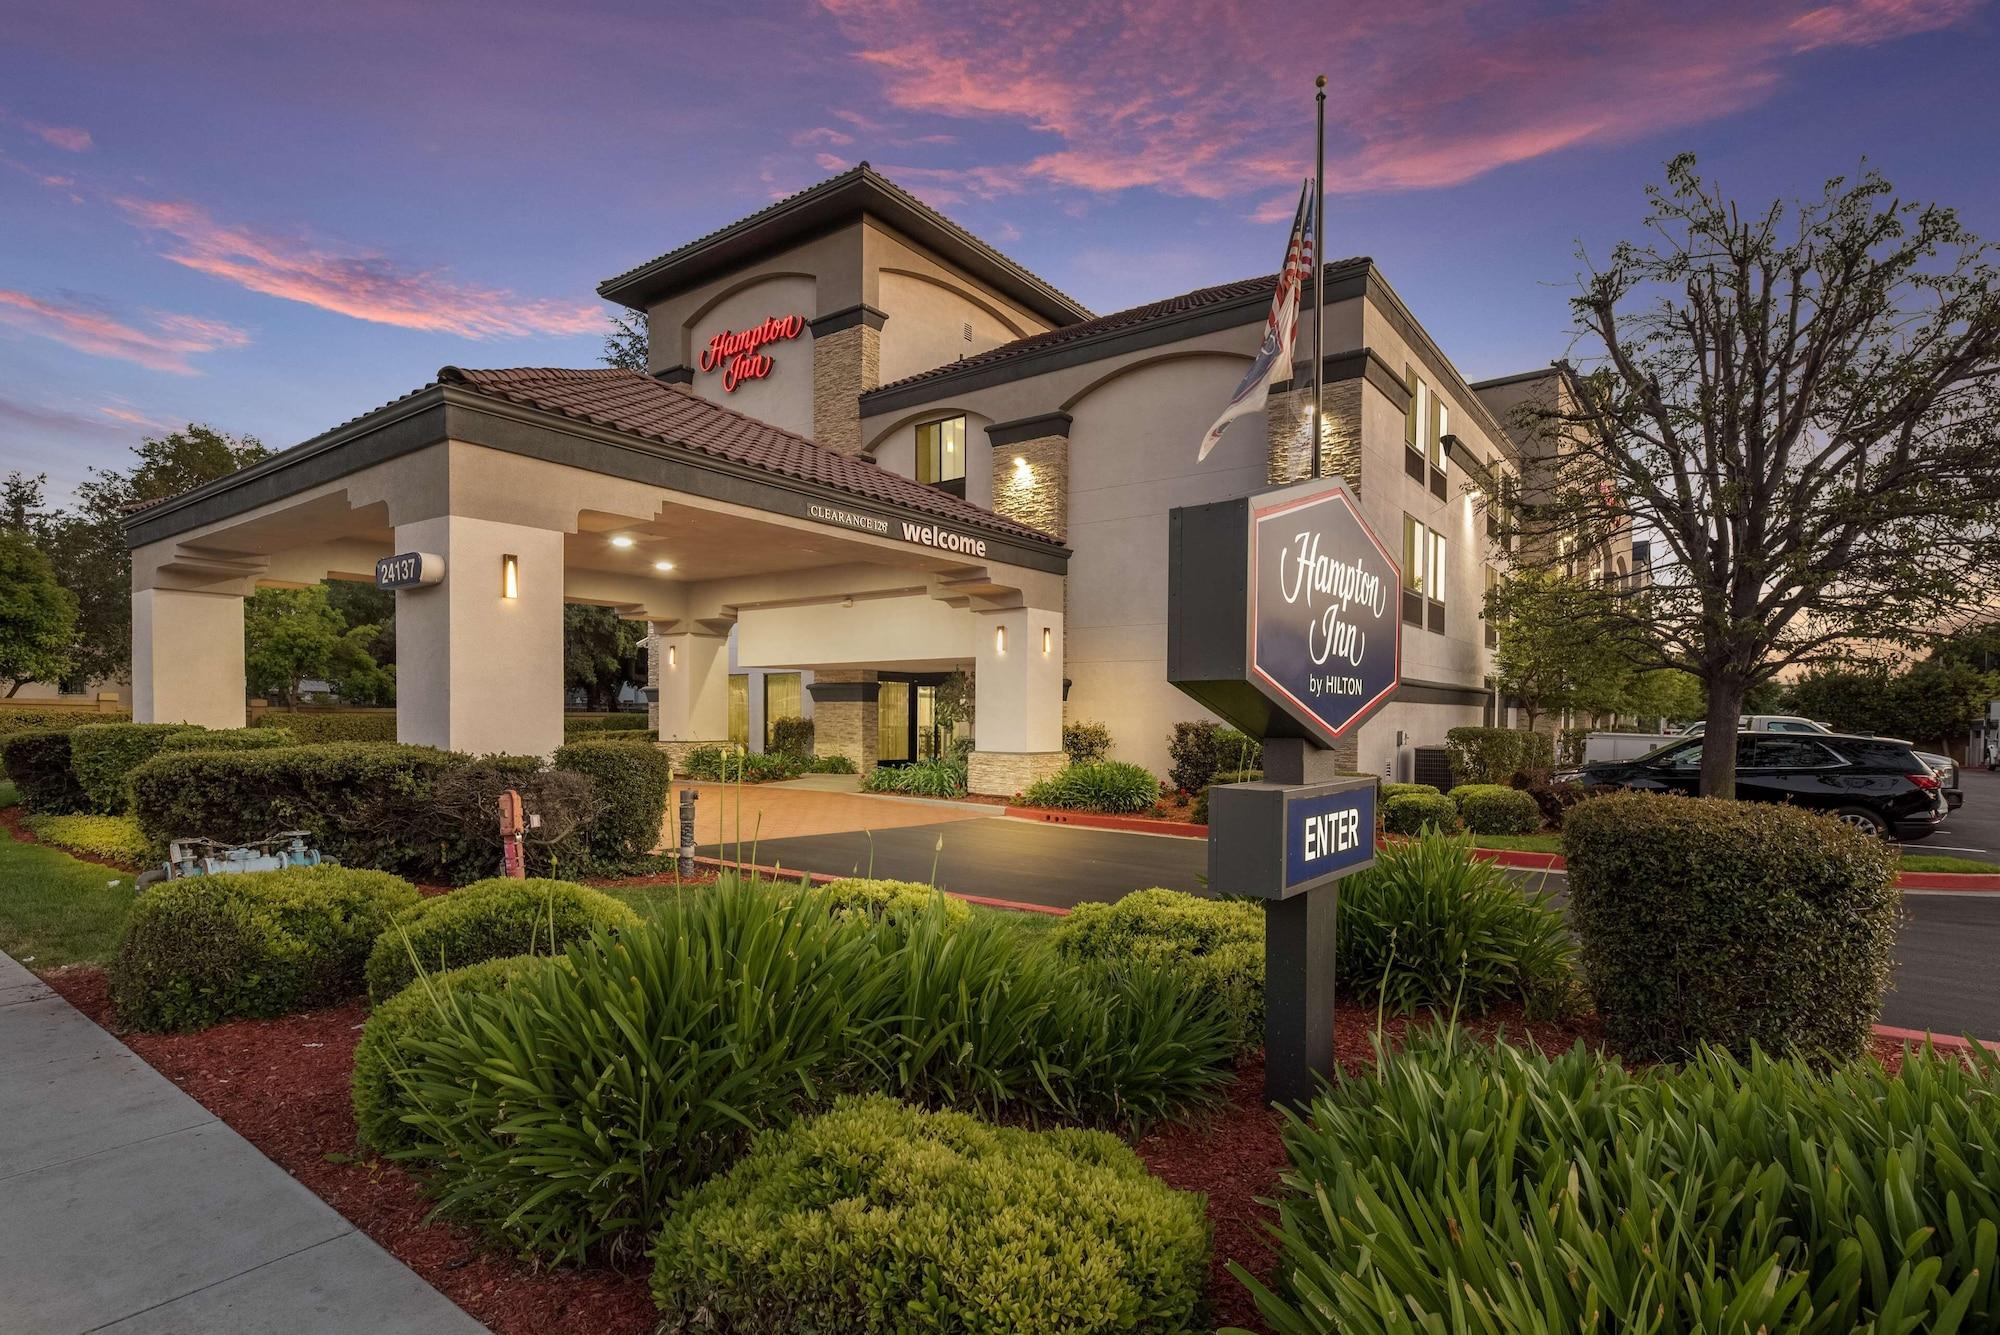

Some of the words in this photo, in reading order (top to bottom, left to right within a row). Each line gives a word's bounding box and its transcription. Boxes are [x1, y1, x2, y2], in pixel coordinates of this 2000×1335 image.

[699, 314, 806, 372] Hampton
[722, 353, 774, 392] Inn
[810, 506, 873, 528] CLEARANCE
[902, 522, 986, 556] welcome
[381, 559, 415, 583] 24137
[1281, 531, 1386, 618] Hampton
[1309, 604, 1365, 666] Inn
[1309, 674, 1323, 697] by
[1326, 676, 1363, 695] HILTON
[1305, 808, 1359, 861] ENTER
